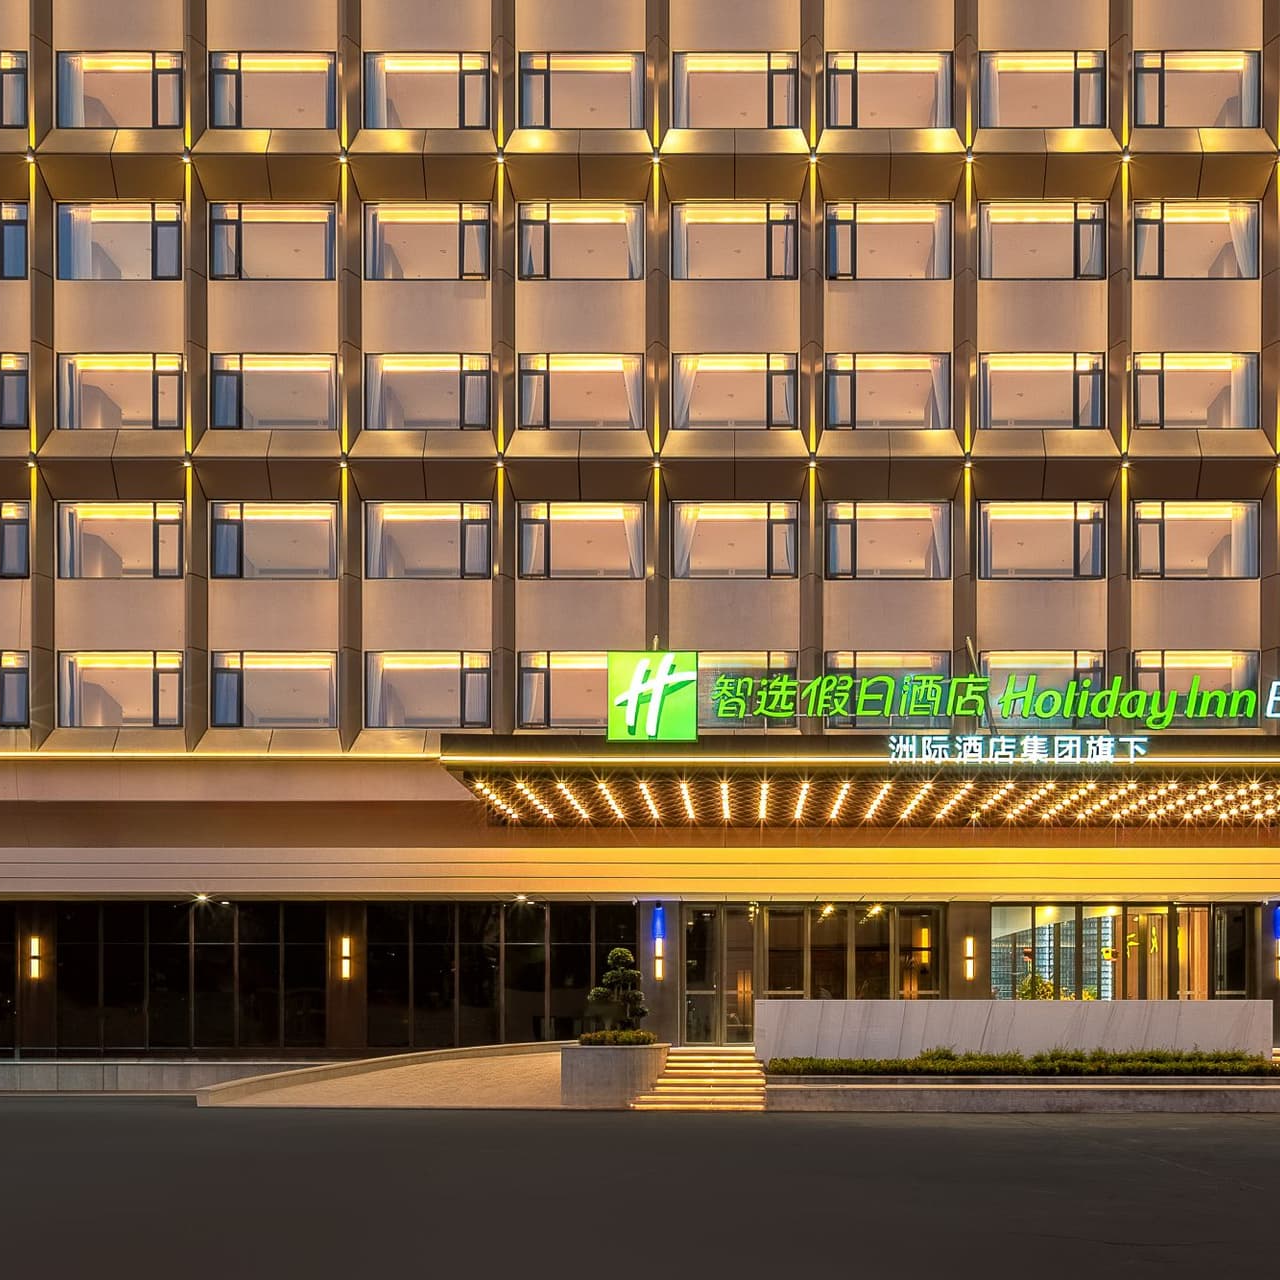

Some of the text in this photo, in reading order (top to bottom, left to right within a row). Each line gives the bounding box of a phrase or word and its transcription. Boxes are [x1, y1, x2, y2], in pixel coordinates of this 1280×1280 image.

[711, 673, 990, 719] 智选假日酒店
[1000, 674, 1179, 729] Holiday
[1186, 674, 1257, 718] Inn
[888, 735, 1149, 765] 洲际酒店集团旗下
